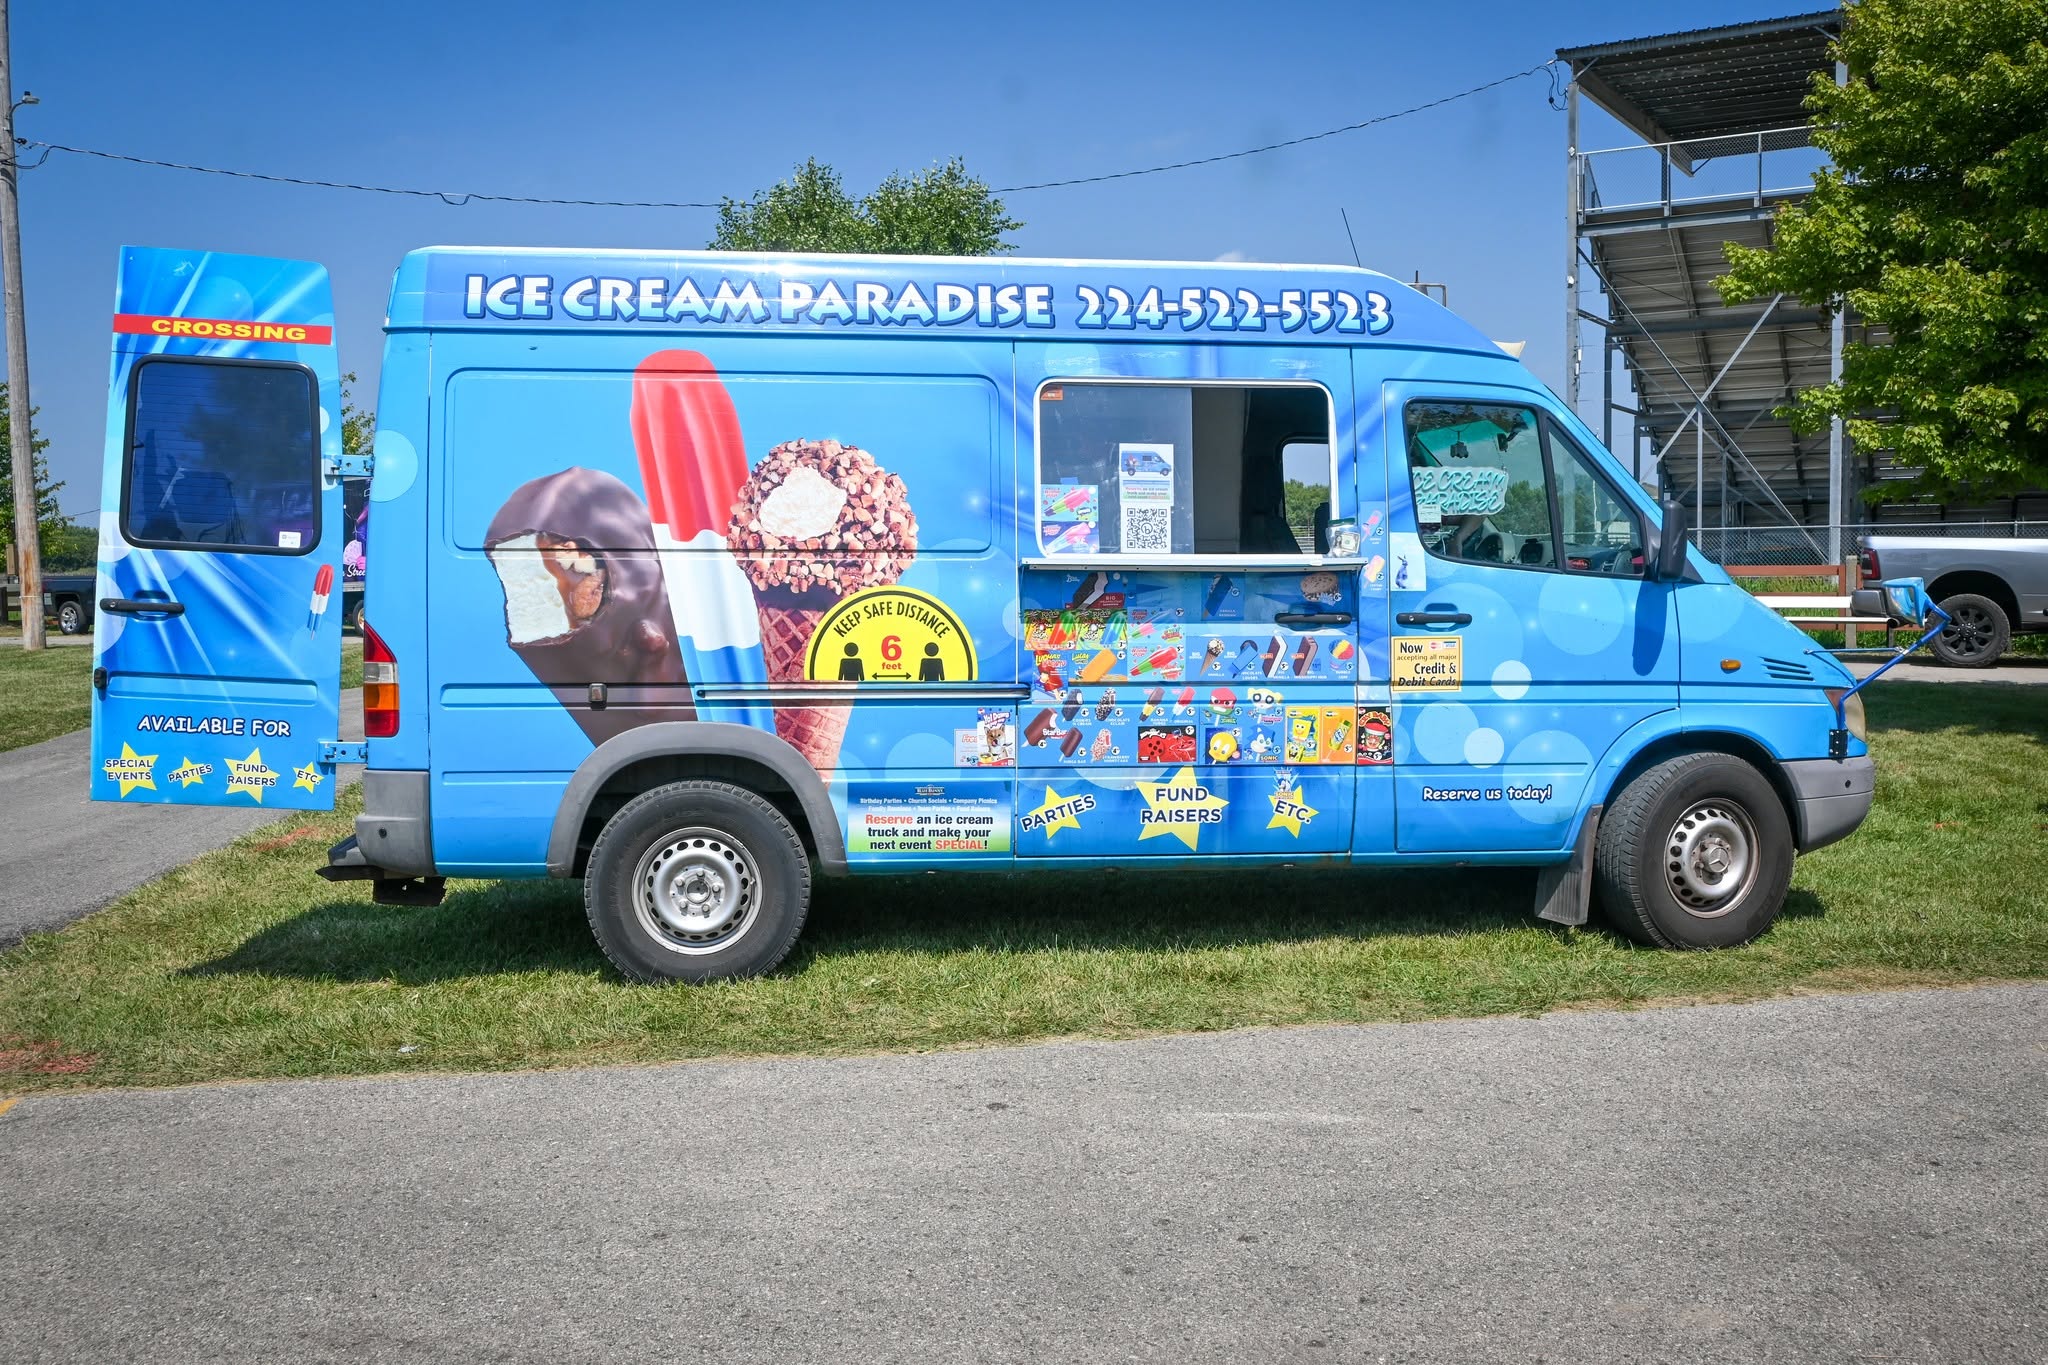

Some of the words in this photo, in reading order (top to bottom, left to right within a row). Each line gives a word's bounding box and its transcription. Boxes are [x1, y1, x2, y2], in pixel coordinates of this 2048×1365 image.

[463, 273, 554, 320] ICE
[562, 275, 770, 323] CREAM
[778, 279, 1056, 329] PARADISE
[1075, 284, 1394, 335] 224-522-5523
[151, 319, 307, 341] CROSSING
[833, 610, 861, 638] KEEP
[863, 601, 893, 620] SAFE
[896, 601, 951, 639] DISTANCE
[881, 635, 902, 661] 6
[1400, 642, 1423, 654] Now
[1439, 654, 1457, 662] major
[881, 661, 902, 670] feet
[1414, 662, 1446, 675] Credit
[1449, 662, 1457, 674] &
[1398, 676, 1426, 687] Debit
[1429, 676, 1457, 687] Cards
[137, 715, 245, 736] AVAILABLE
[251, 718, 292, 737] FOR
[105, 759, 153, 769] SPECIAL
[236, 763, 268, 774] FUND
[107, 771, 152, 781] EVENTS
[168, 764, 213, 782] PARTIES
[296, 769, 321, 785] ETC.
[227, 775, 276, 786] RAISERS
[1155, 787, 1209, 802] FUND
[1423, 787, 1480, 801] Reserve
[1486, 788, 1502, 801] us
[1507, 784, 1553, 803] today!
[1021, 795, 1096, 831] PARTIES
[1141, 808, 1222, 824] RAISERS
[1273, 799, 1312, 823] ETC.
[865, 814, 913, 825] Reserve
[916, 816, 931, 825] an
[935, 814, 953, 825] ice
[956, 816, 993, 825] cream
[868, 827, 899, 838] truck
[902, 827, 925, 838] and
[928, 827, 961, 838] make
[964, 829, 992, 840] your
[870, 840, 896, 850] next
[899, 840, 932, 850] event
[935, 840, 988, 850] SPECIAL!
